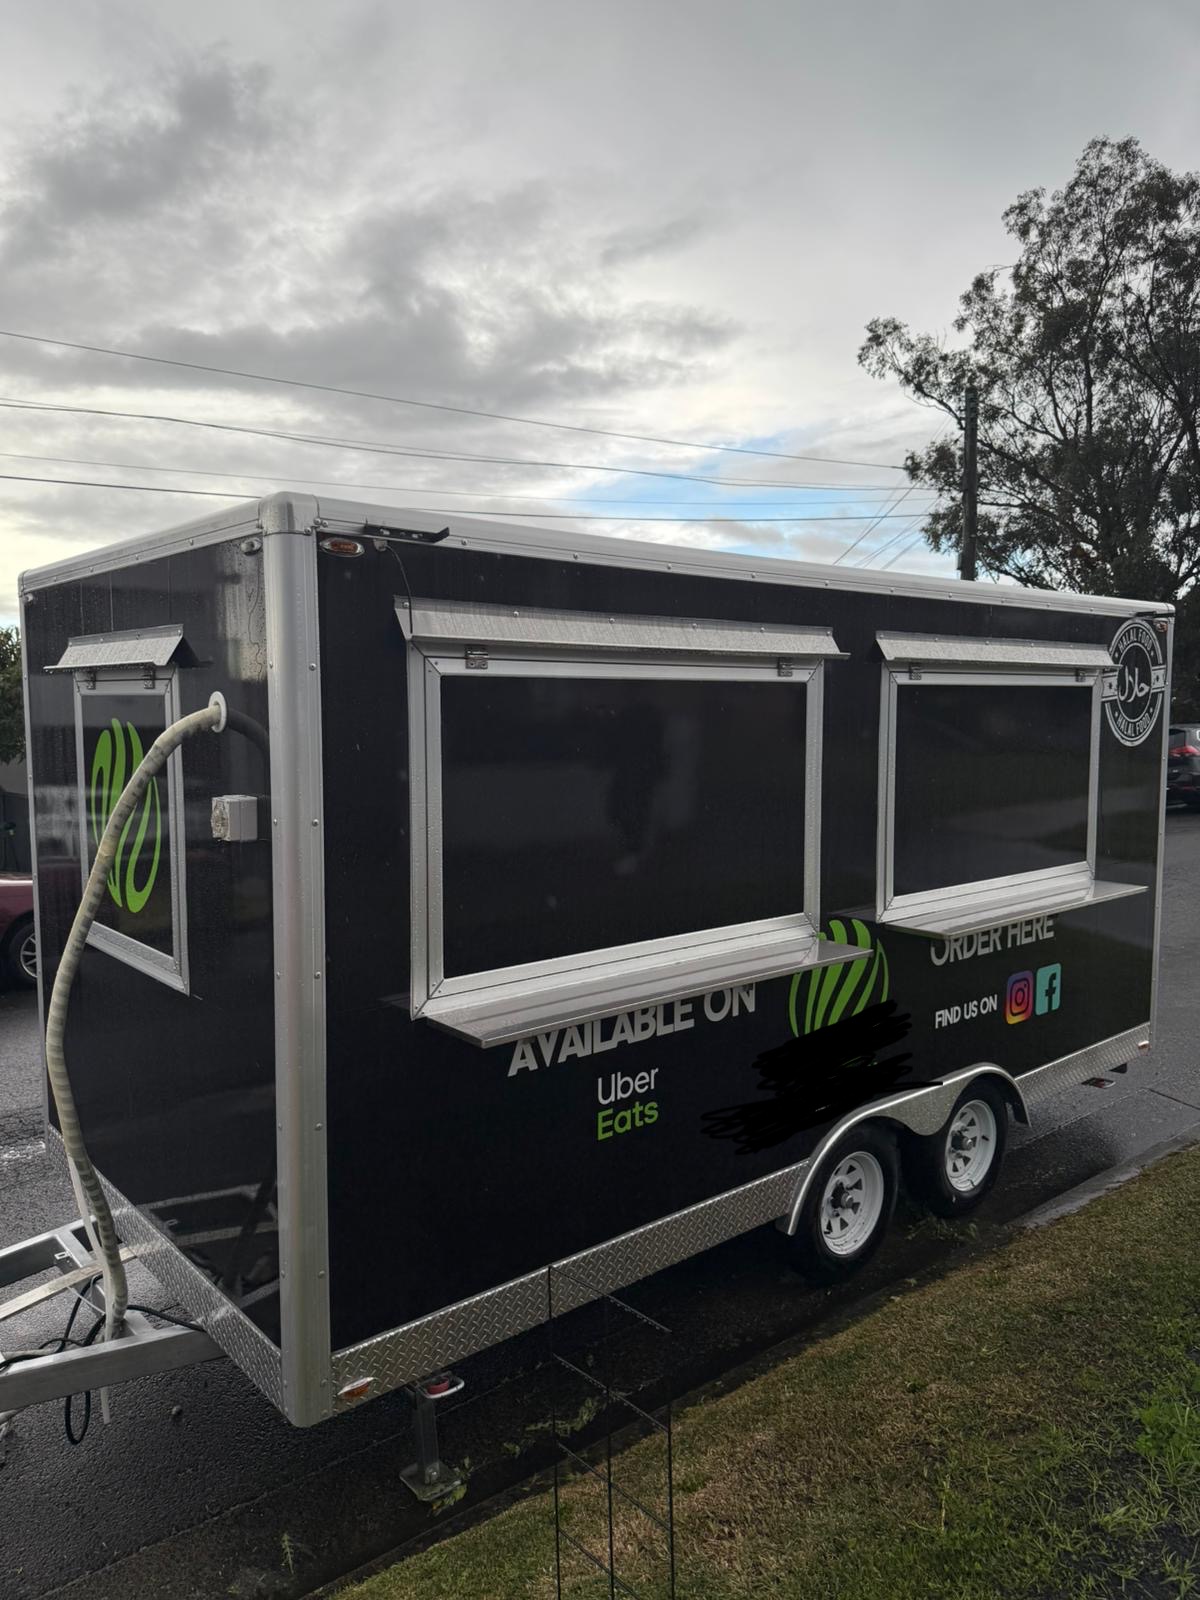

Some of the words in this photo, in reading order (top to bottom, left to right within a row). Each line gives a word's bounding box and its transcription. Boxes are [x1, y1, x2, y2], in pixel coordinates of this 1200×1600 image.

[1118, 628, 1137, 652] HALAL
[1138, 629, 1153, 652] FOOD
[1119, 666, 1150, 702] حلال
[1117, 714, 1135, 737] HALAL
[1136, 712, 1150, 734] FOOD
[931, 929, 1001, 966] ORDER
[1008, 916, 1053, 948] HERE
[935, 1006, 961, 1029] FIND
[963, 1000, 978, 1019] US
[980, 995, 998, 1014] ON
[508, 1001, 694, 1077] AVAILABLE
[704, 984, 755, 1021] ON
[597, 1068, 659, 1105] Uber
[597, 1101, 659, 1141] Eats
